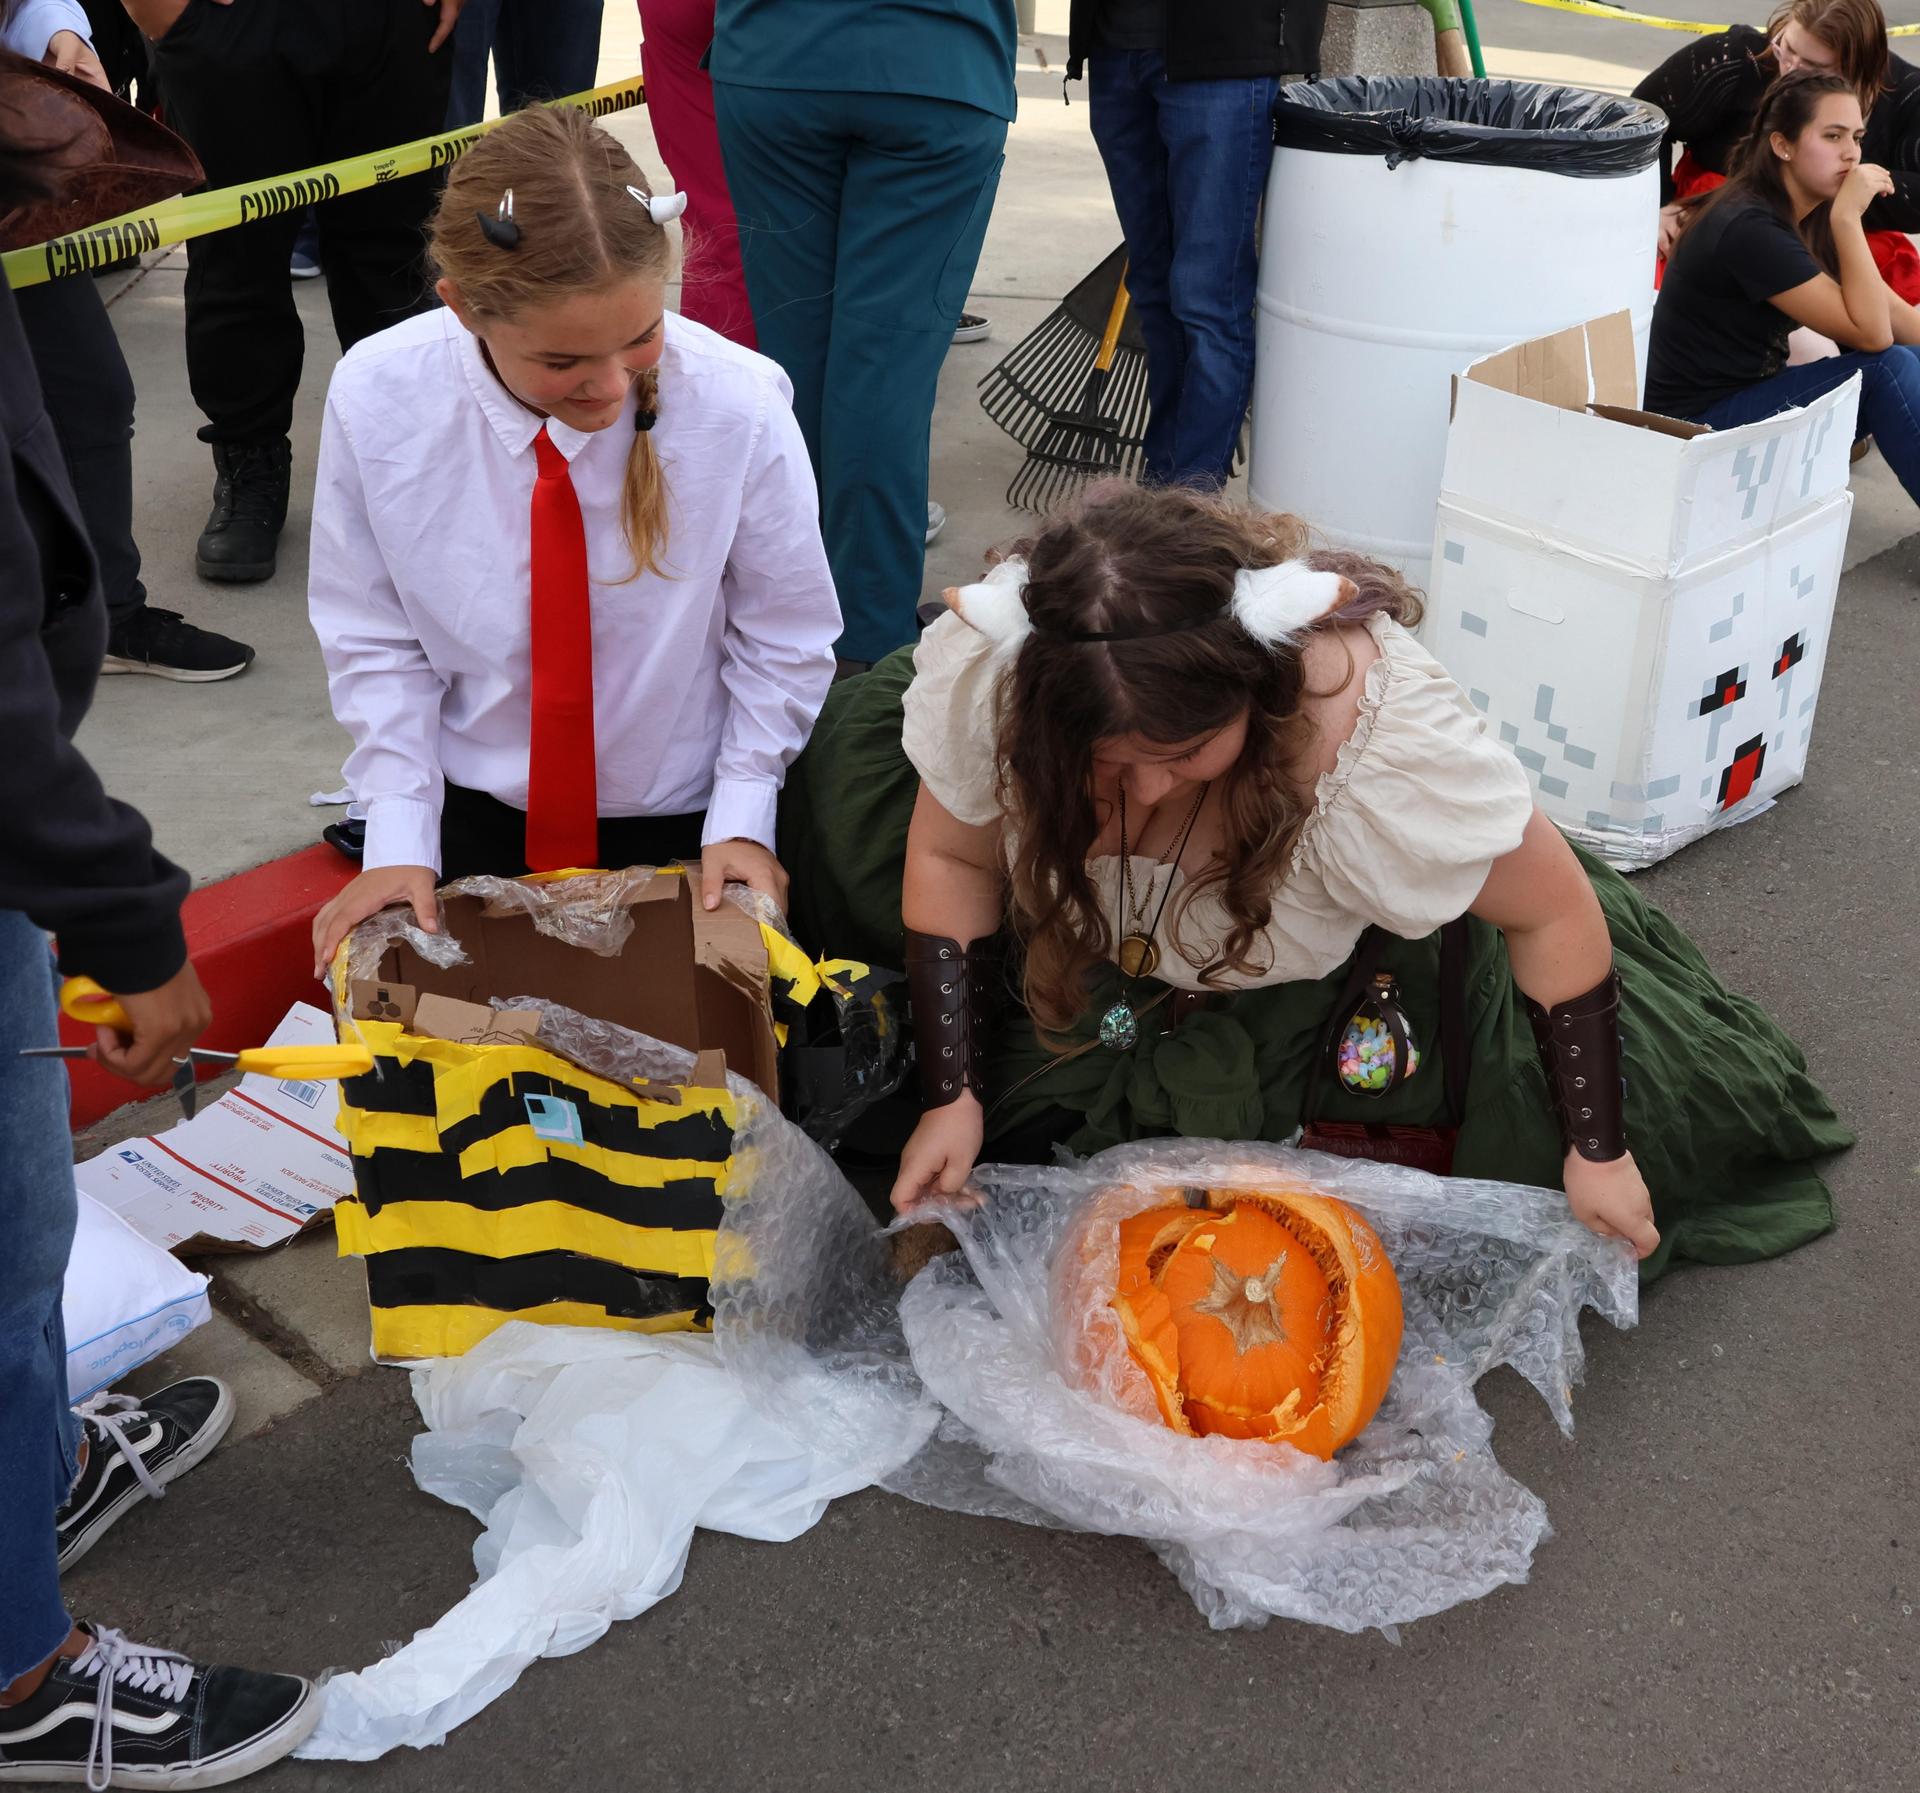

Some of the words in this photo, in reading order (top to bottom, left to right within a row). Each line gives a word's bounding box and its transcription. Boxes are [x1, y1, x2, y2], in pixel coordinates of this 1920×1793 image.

[239, 172, 340, 224] CUIDADO
[45, 217, 161, 280] CAUTION
[208, 1160, 248, 1183] PRIORITY
[228, 1163, 246, 1175] MAIL
[190, 1191, 226, 1212] PRIORITY
[190, 1199, 209, 1212] MAIL
